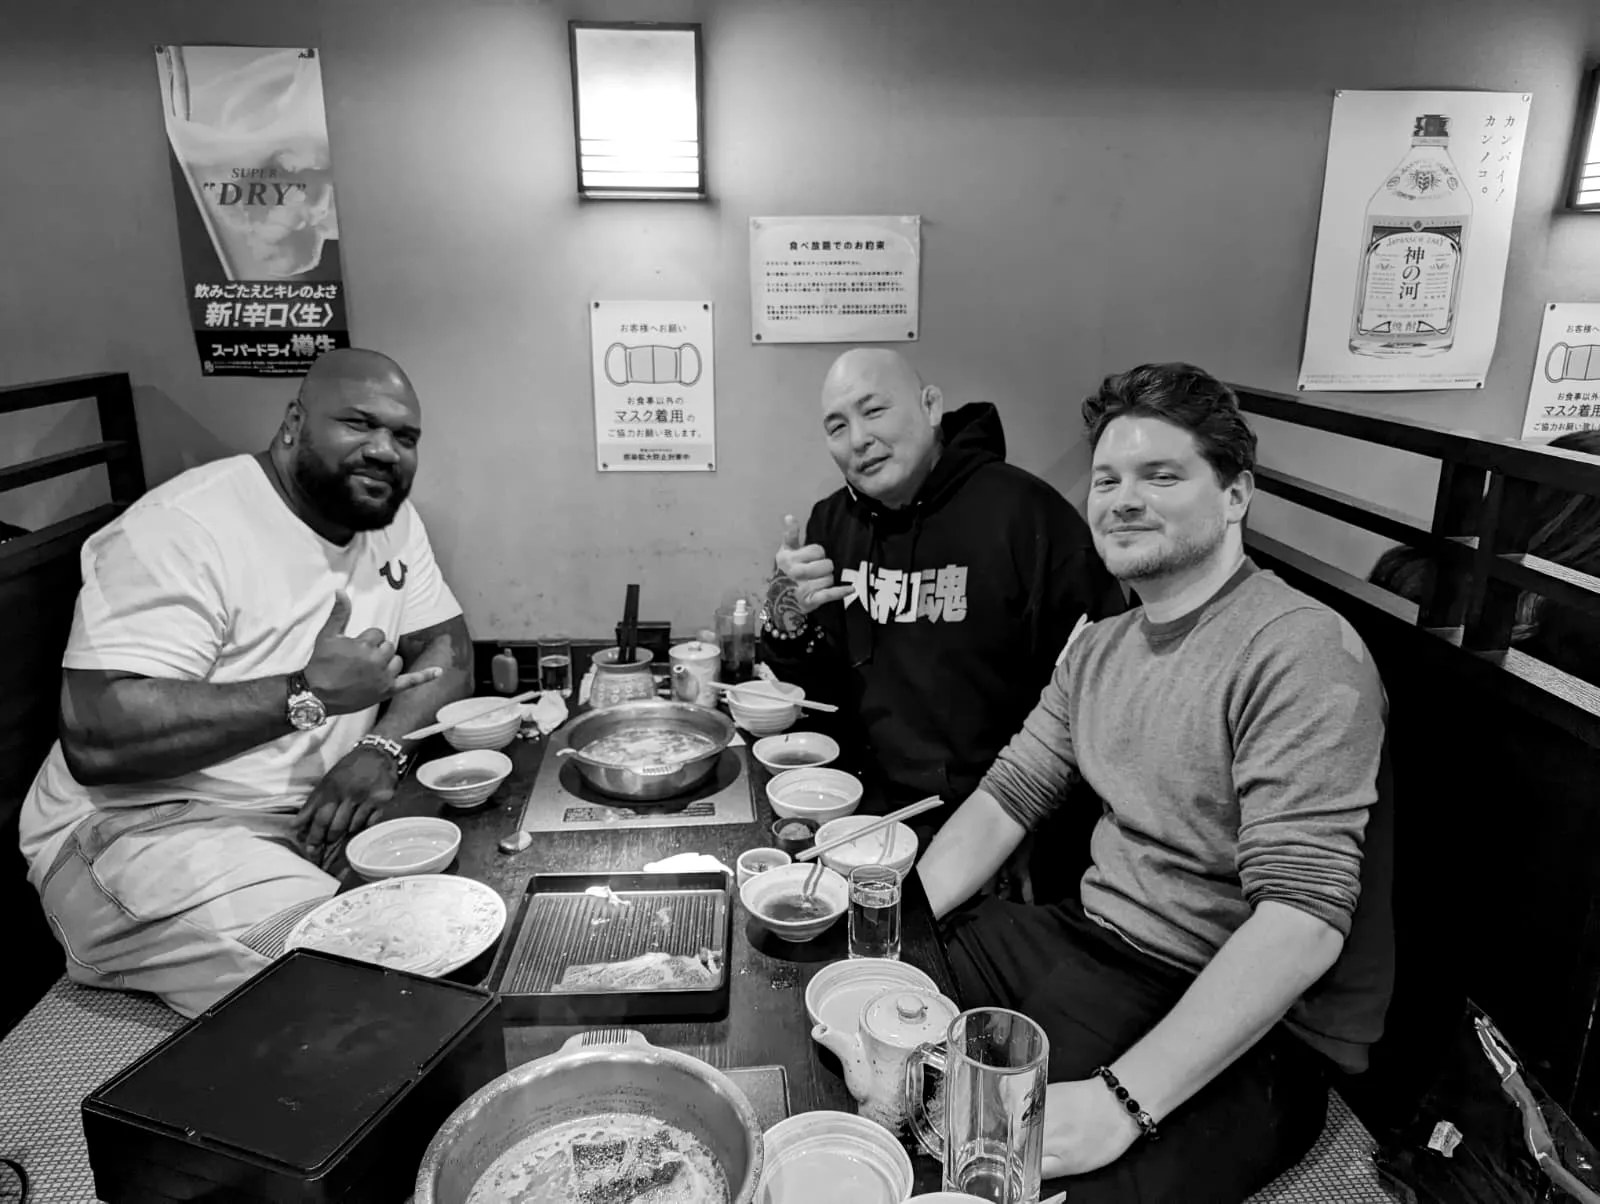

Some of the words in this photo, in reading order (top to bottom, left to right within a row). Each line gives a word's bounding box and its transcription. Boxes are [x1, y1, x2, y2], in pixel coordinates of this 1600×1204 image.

[789, 240, 885, 251] 食べ放題でのお約束
[1400, 246, 1425, 300] 神の河
[194, 283, 338, 299] 飲みごたえとキレのよさ
[620, 323, 688, 333] お客様へお願い
[627, 396, 685, 405] お食事以外の
